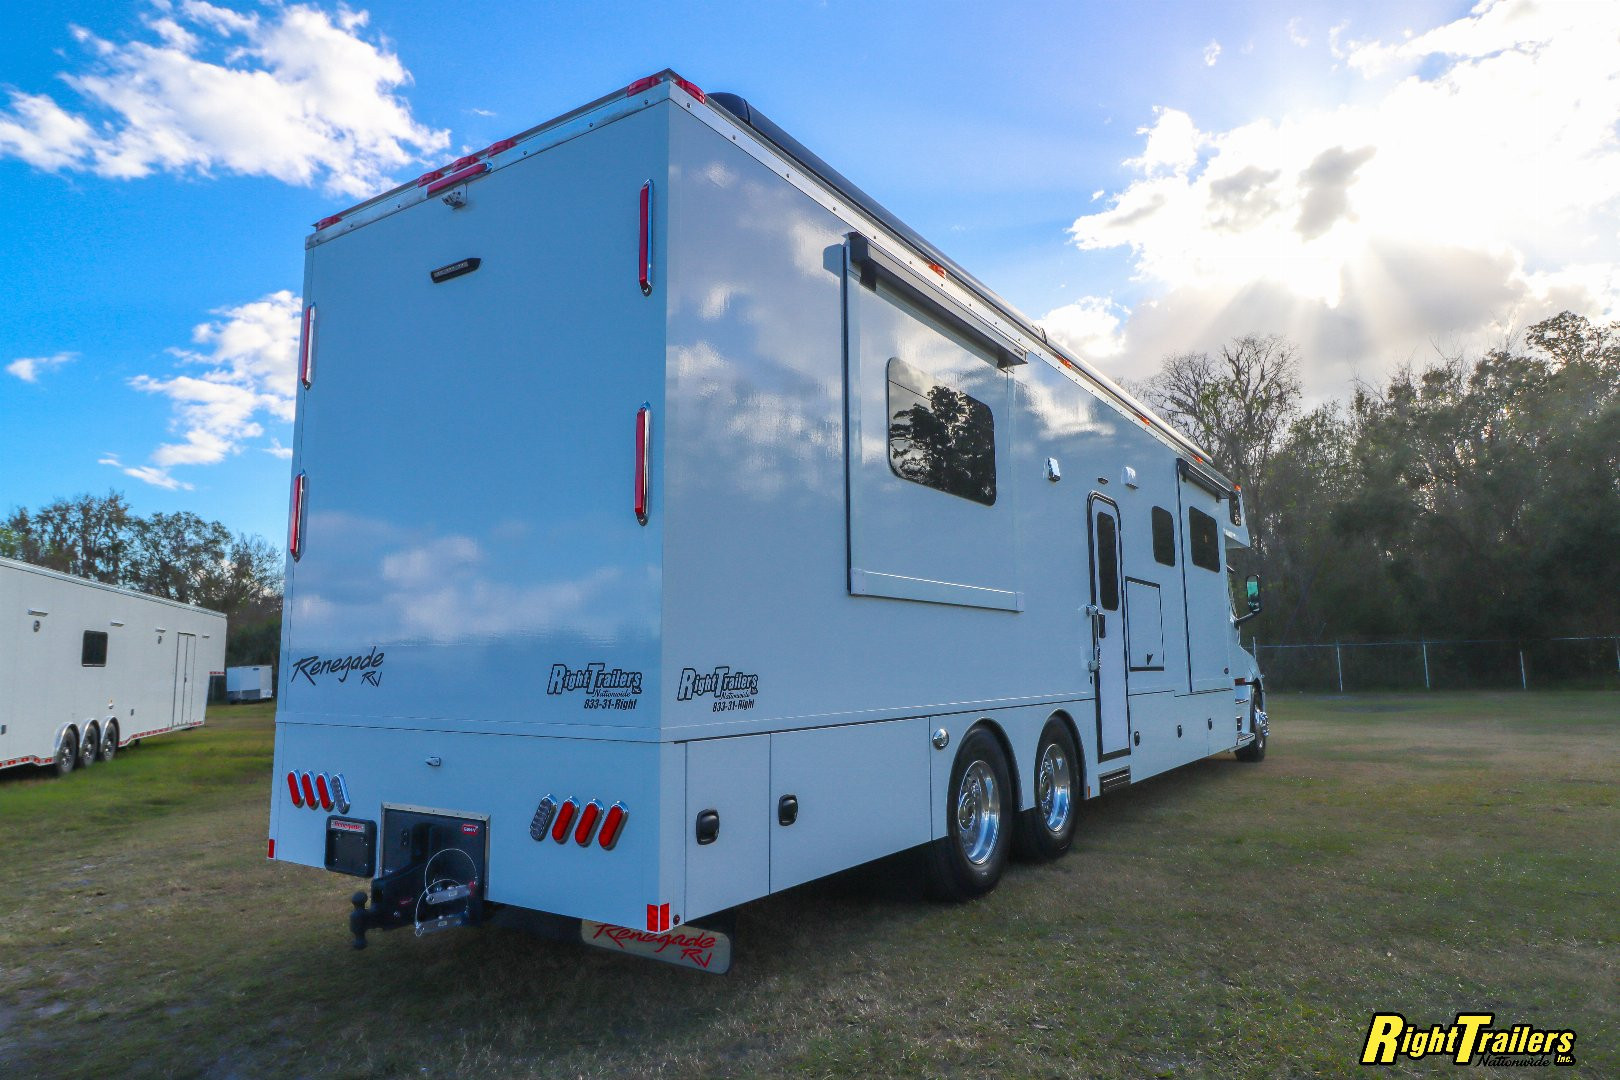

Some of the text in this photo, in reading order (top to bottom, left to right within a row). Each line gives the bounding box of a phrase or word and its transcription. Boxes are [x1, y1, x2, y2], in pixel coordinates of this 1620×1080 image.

[291, 646, 384, 686] Renegade
[361, 671, 382, 687] RV
[584, 699, 638, 711] 833-31-Right
[680, 948, 712, 969] RV
